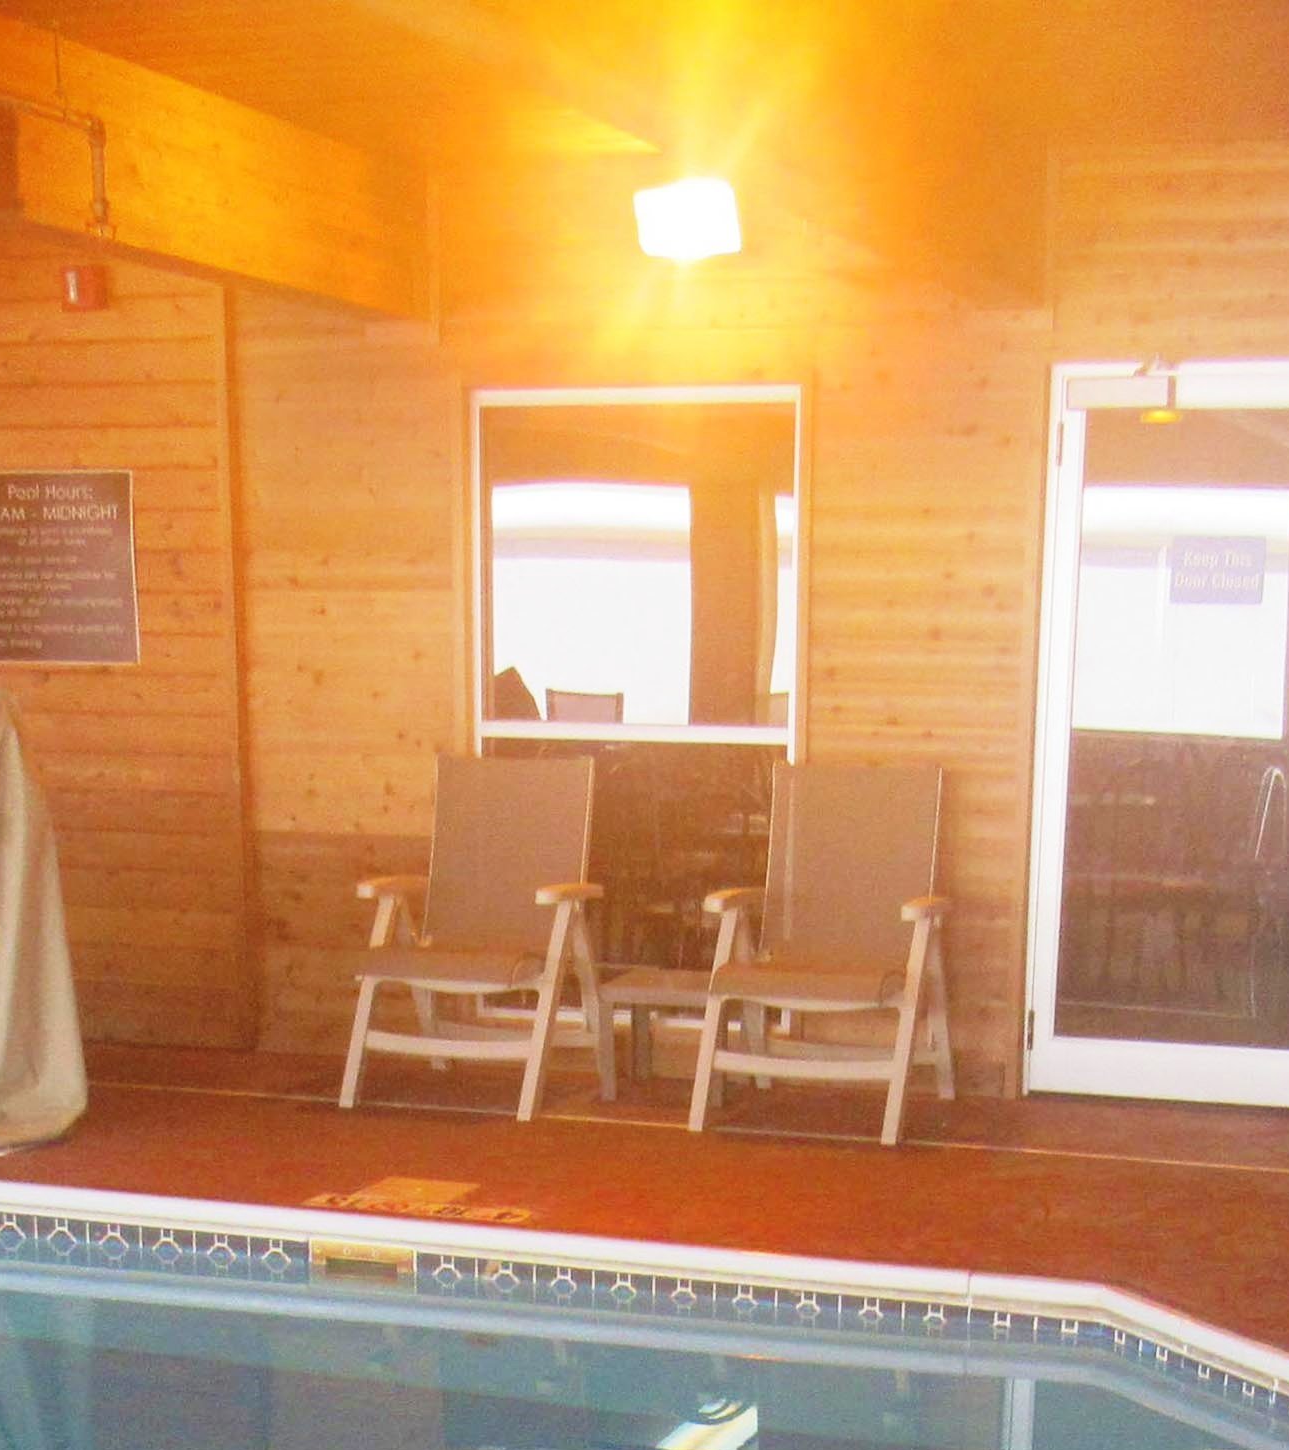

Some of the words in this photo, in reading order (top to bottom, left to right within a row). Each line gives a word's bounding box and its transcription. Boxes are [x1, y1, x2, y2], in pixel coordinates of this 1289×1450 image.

[7, 483, 39, 500] Pool
[0, 506, 25, 521] AM
[43, 502, 119, 520] MIDNIGHT
